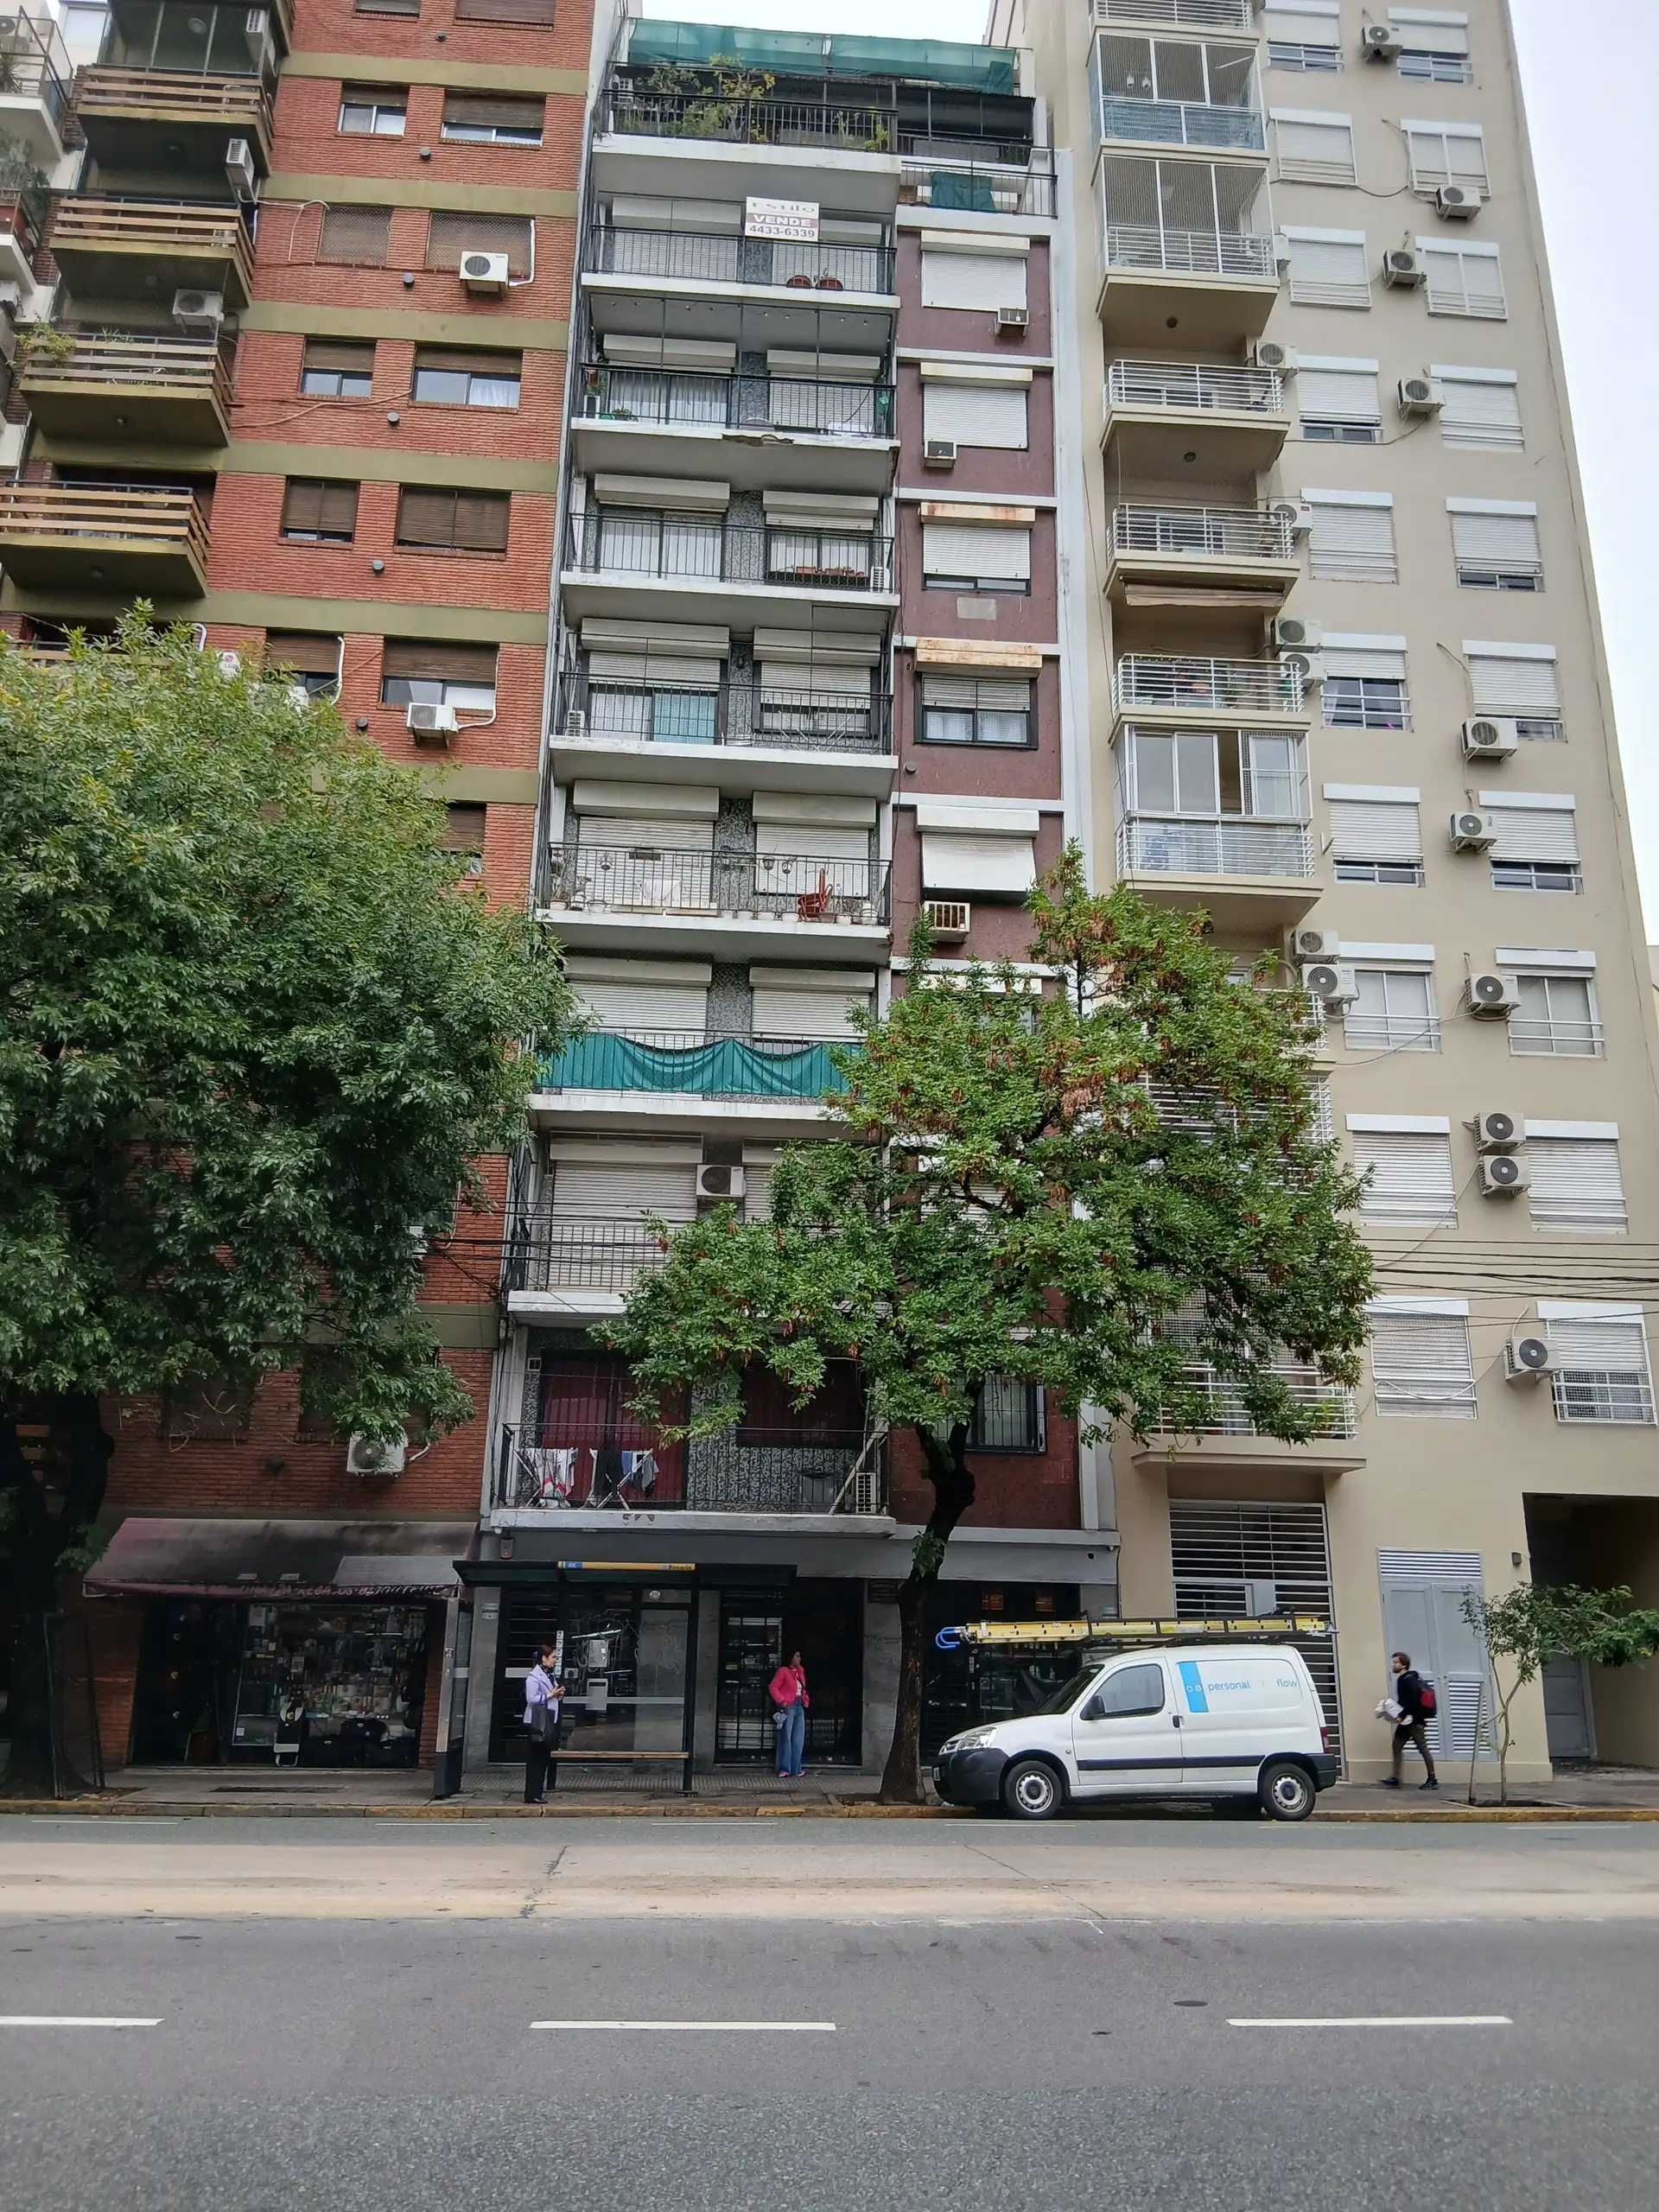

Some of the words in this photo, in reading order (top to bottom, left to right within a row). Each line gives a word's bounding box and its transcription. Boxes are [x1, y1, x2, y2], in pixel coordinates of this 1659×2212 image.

[753, 214, 811, 227] VENDE
[749, 225, 815, 238] 4433-6339
[1208, 1680, 1251, 1692] personal
[1276, 1679, 1298, 1688] flow
